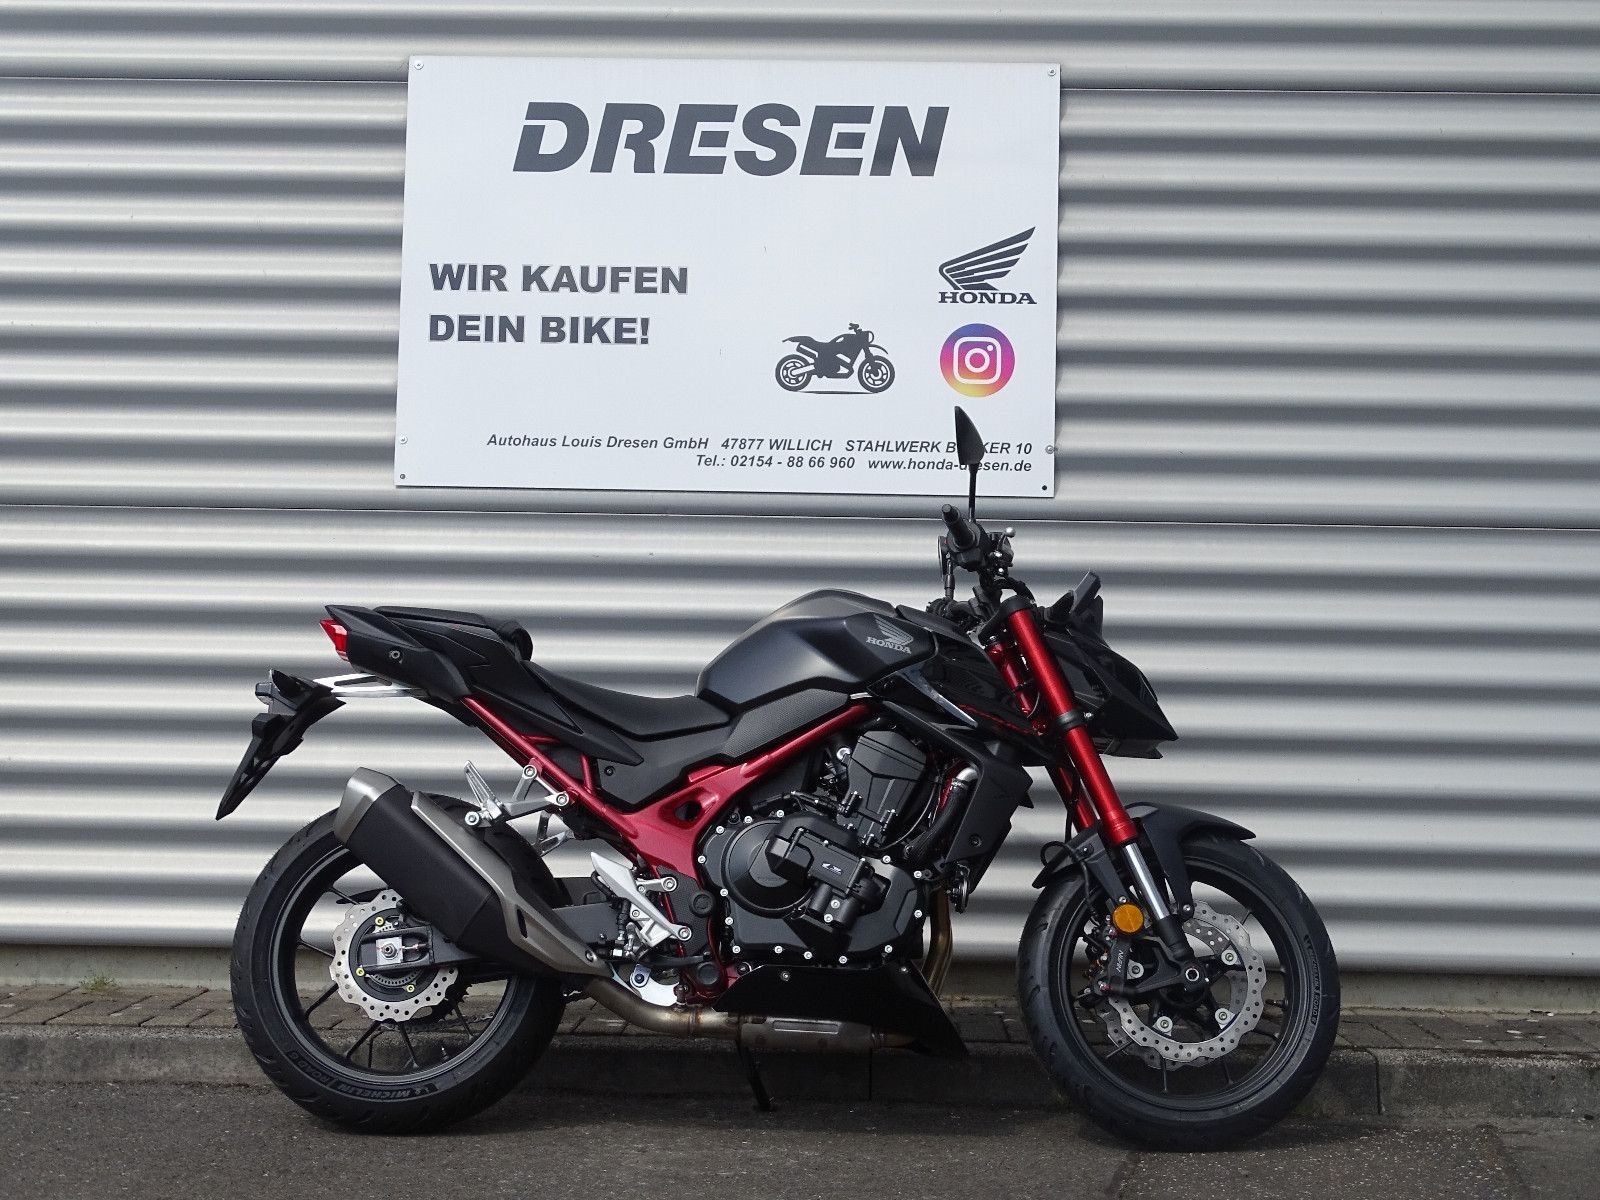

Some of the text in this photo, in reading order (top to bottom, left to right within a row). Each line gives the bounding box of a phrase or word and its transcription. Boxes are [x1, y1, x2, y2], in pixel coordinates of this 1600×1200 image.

[513, 102, 949, 176] DRESEN
[429, 263, 688, 294] WIR KAUFEN
[938, 288, 1038, 305] HONDA
[429, 314, 650, 345] DEIN BIKE!
[486, 433, 1033, 455] Autohaus Louis Dresen GmbH 47877 WILLICH STAHLWERK BKER 10
[696, 454, 726, 467] Tel.:
[730, 454, 773, 468] 02154
[786, 455, 804, 468] 88
[808, 456, 826, 469] 66
[829, 456, 856, 469] 960
[868, 457, 1033, 472] www.honda-esen.de
[866, 637, 912, 653] HONDA
[298, 1060, 331, 1085] ROAD
[337, 1083, 411, 1099] MICHELIN
